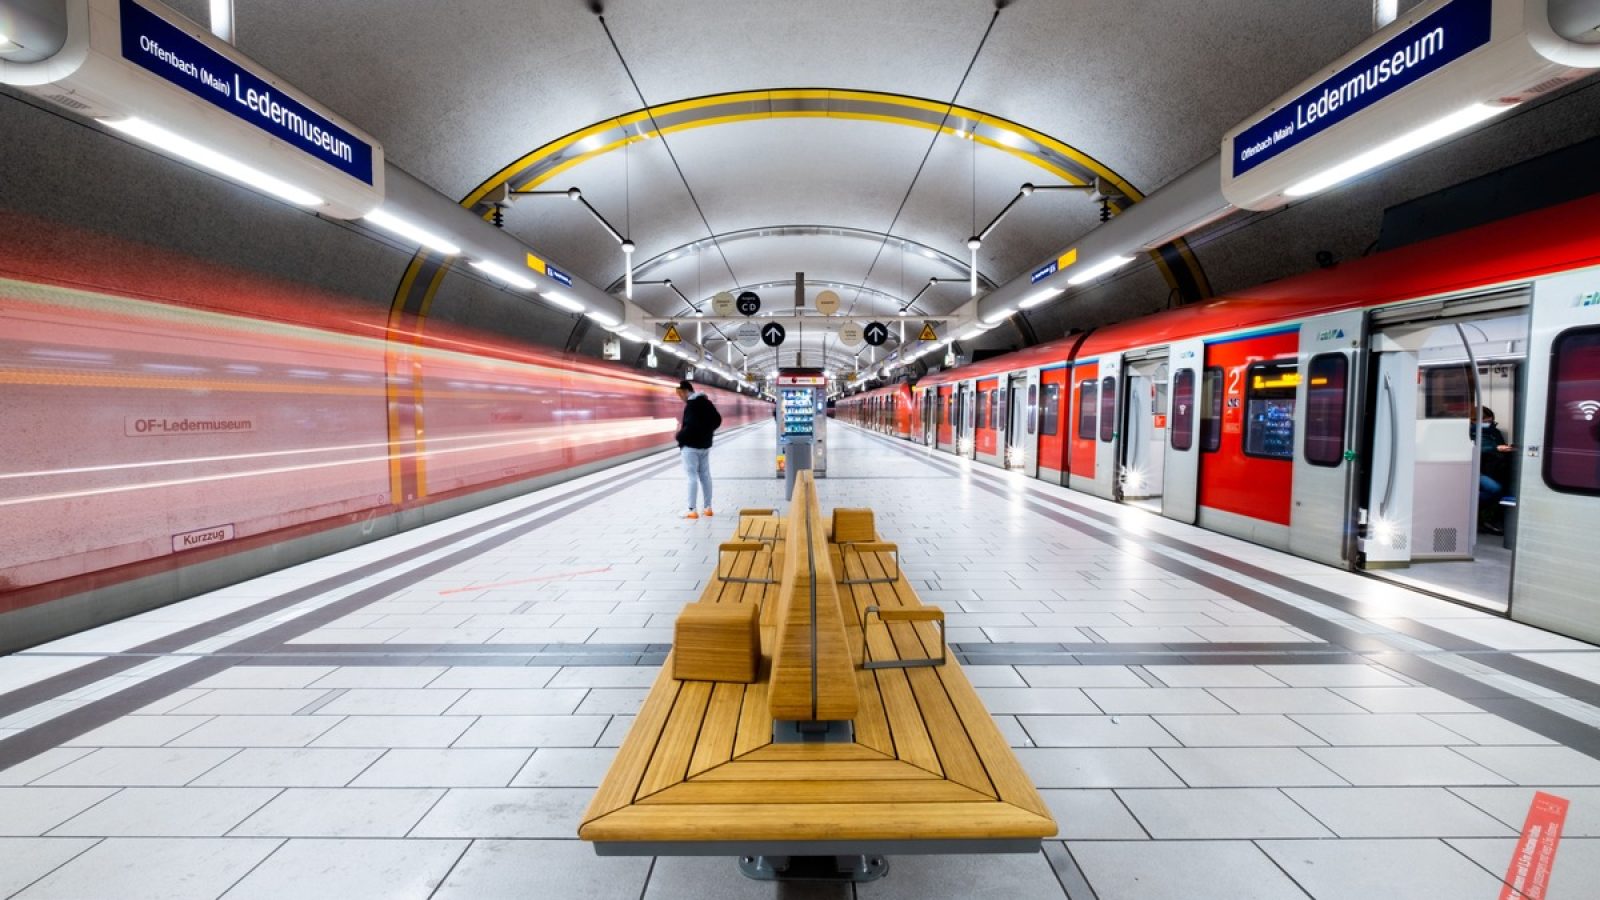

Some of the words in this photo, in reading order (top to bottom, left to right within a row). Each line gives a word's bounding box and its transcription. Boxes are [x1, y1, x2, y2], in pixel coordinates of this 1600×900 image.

[140, 35, 198, 79] Offenbach
[200, 67, 230, 97] (Main)
[234, 73, 353, 163] Ledermuseum
[1241, 135, 1272, 161] Offenbach
[1273, 121, 1294, 144] (Main)
[1297, 26, 1444, 130] Ledermuseum
[1228, 366, 1240, 394] 2
[135, 418, 252, 433] OF-Ledermuseum
[183, 528, 225, 546] Kurzzug
